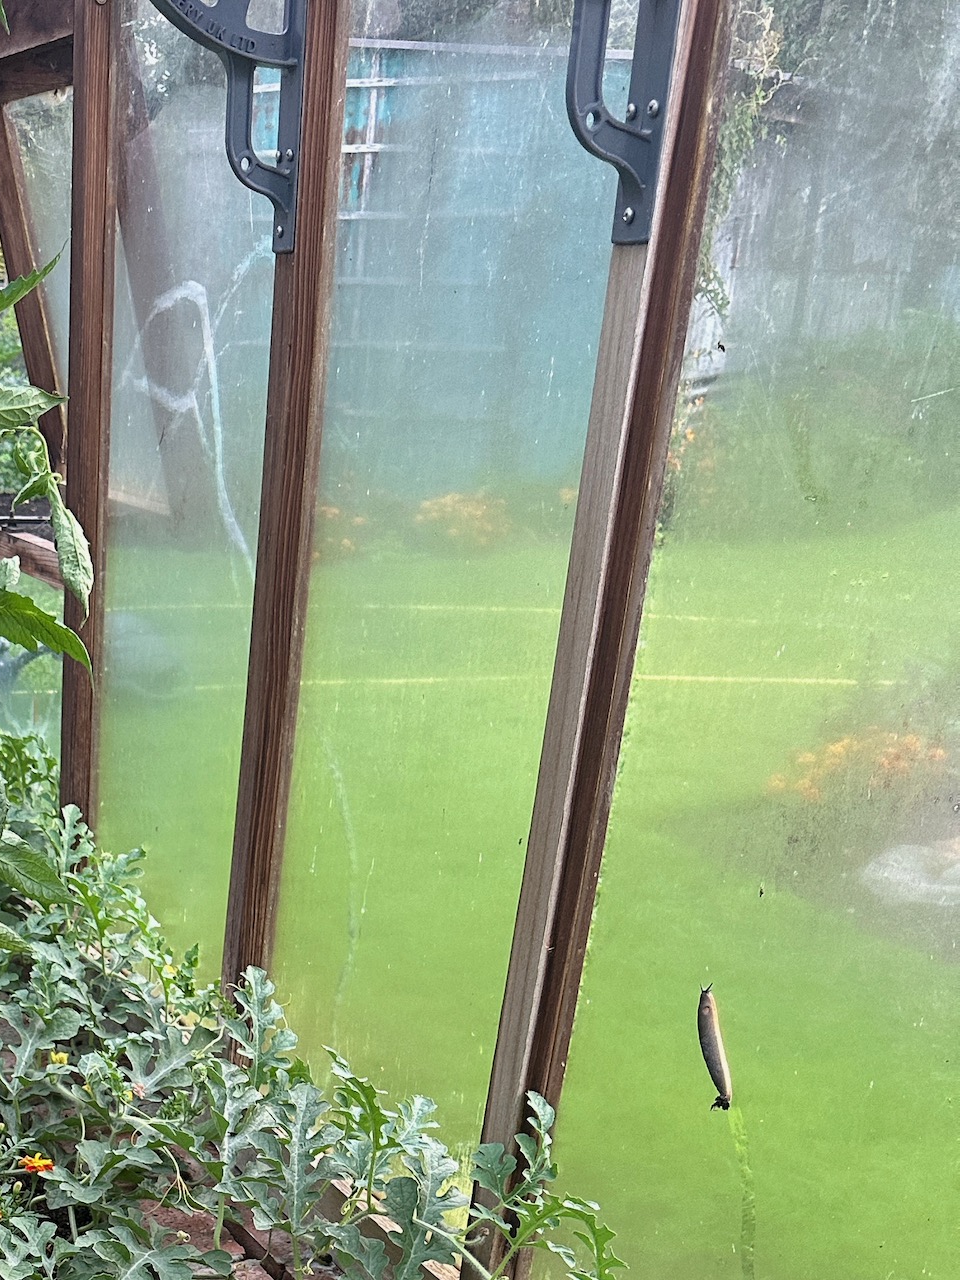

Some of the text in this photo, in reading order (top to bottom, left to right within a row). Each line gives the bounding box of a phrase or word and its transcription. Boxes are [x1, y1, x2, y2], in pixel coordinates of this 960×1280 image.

[171, 0, 256, 53] ERY UK LTD
